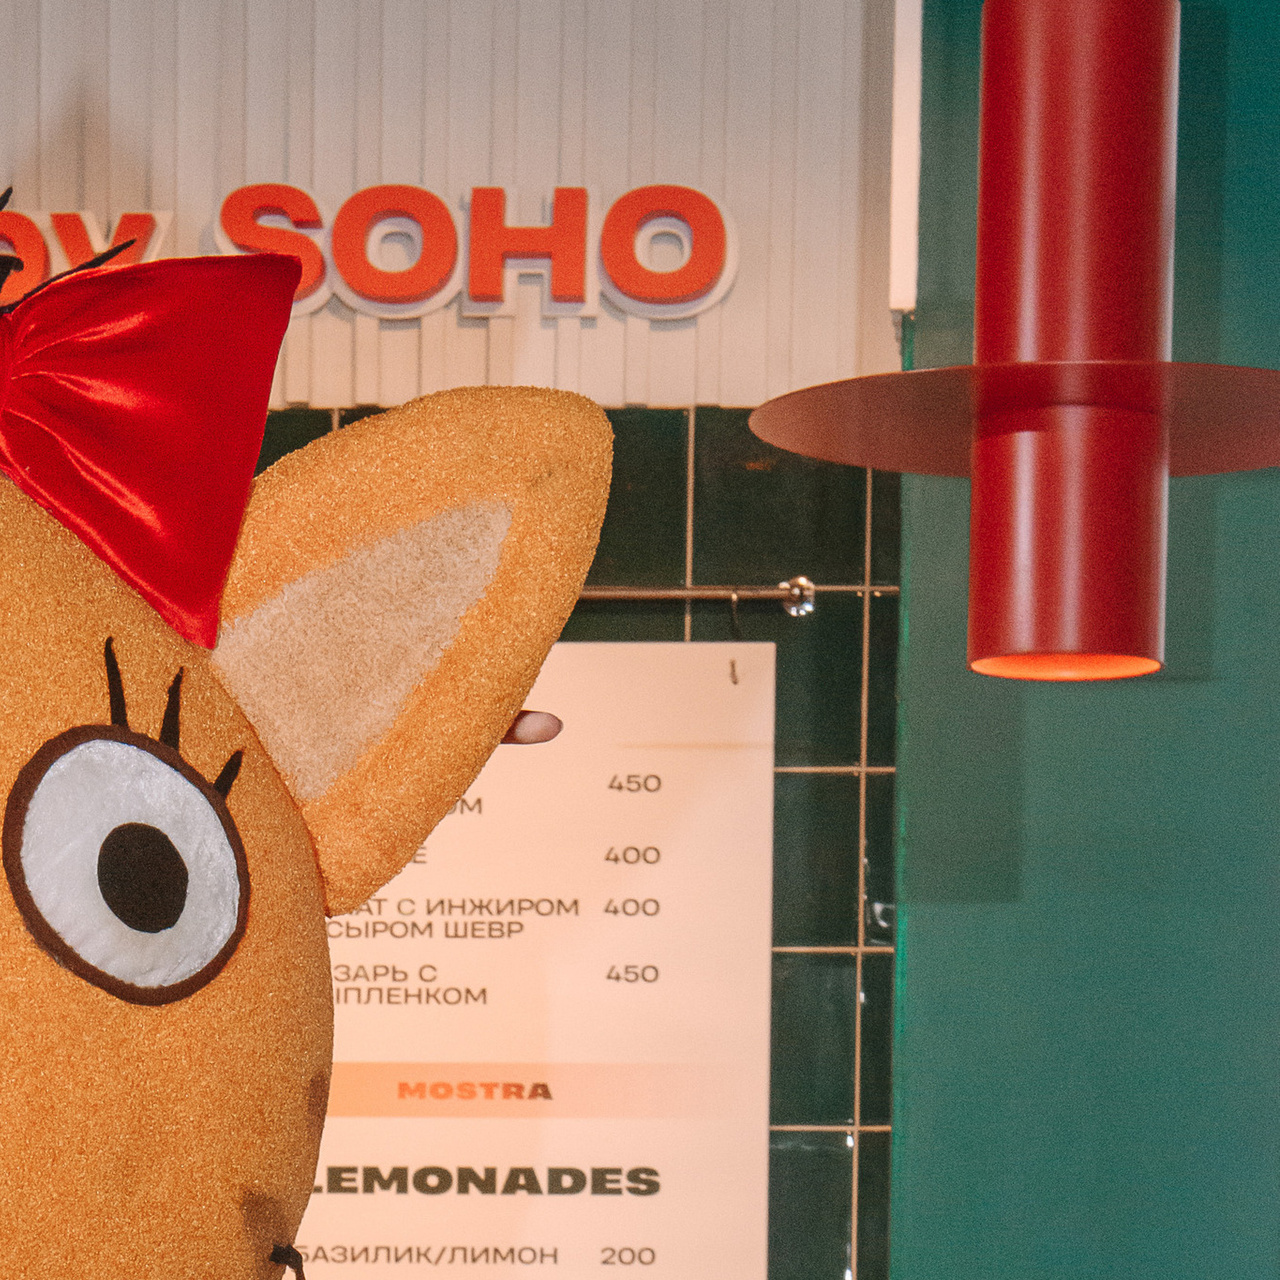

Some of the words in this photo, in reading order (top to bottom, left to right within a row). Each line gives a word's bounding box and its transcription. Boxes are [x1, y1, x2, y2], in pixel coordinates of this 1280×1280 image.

[221, 183, 722, 304] SOHO
[607, 773, 663, 794] 450
[604, 845, 662, 865] 400
[354, 896, 390, 916] АТ
[396, 897, 416, 917] С
[425, 897, 580, 917] ИНЖИРОМ
[603, 897, 661, 917] 400
[327, 920, 434, 939] СЫРОМ
[443, 920, 525, 940] ШЕВР
[417, 963, 438, 984] С
[605, 964, 660, 984] 450
[397, 1081, 553, 1100] MOSTRA
[313, 1166, 660, 1196] EMONADES
[600, 1246, 657, 1266] 200
